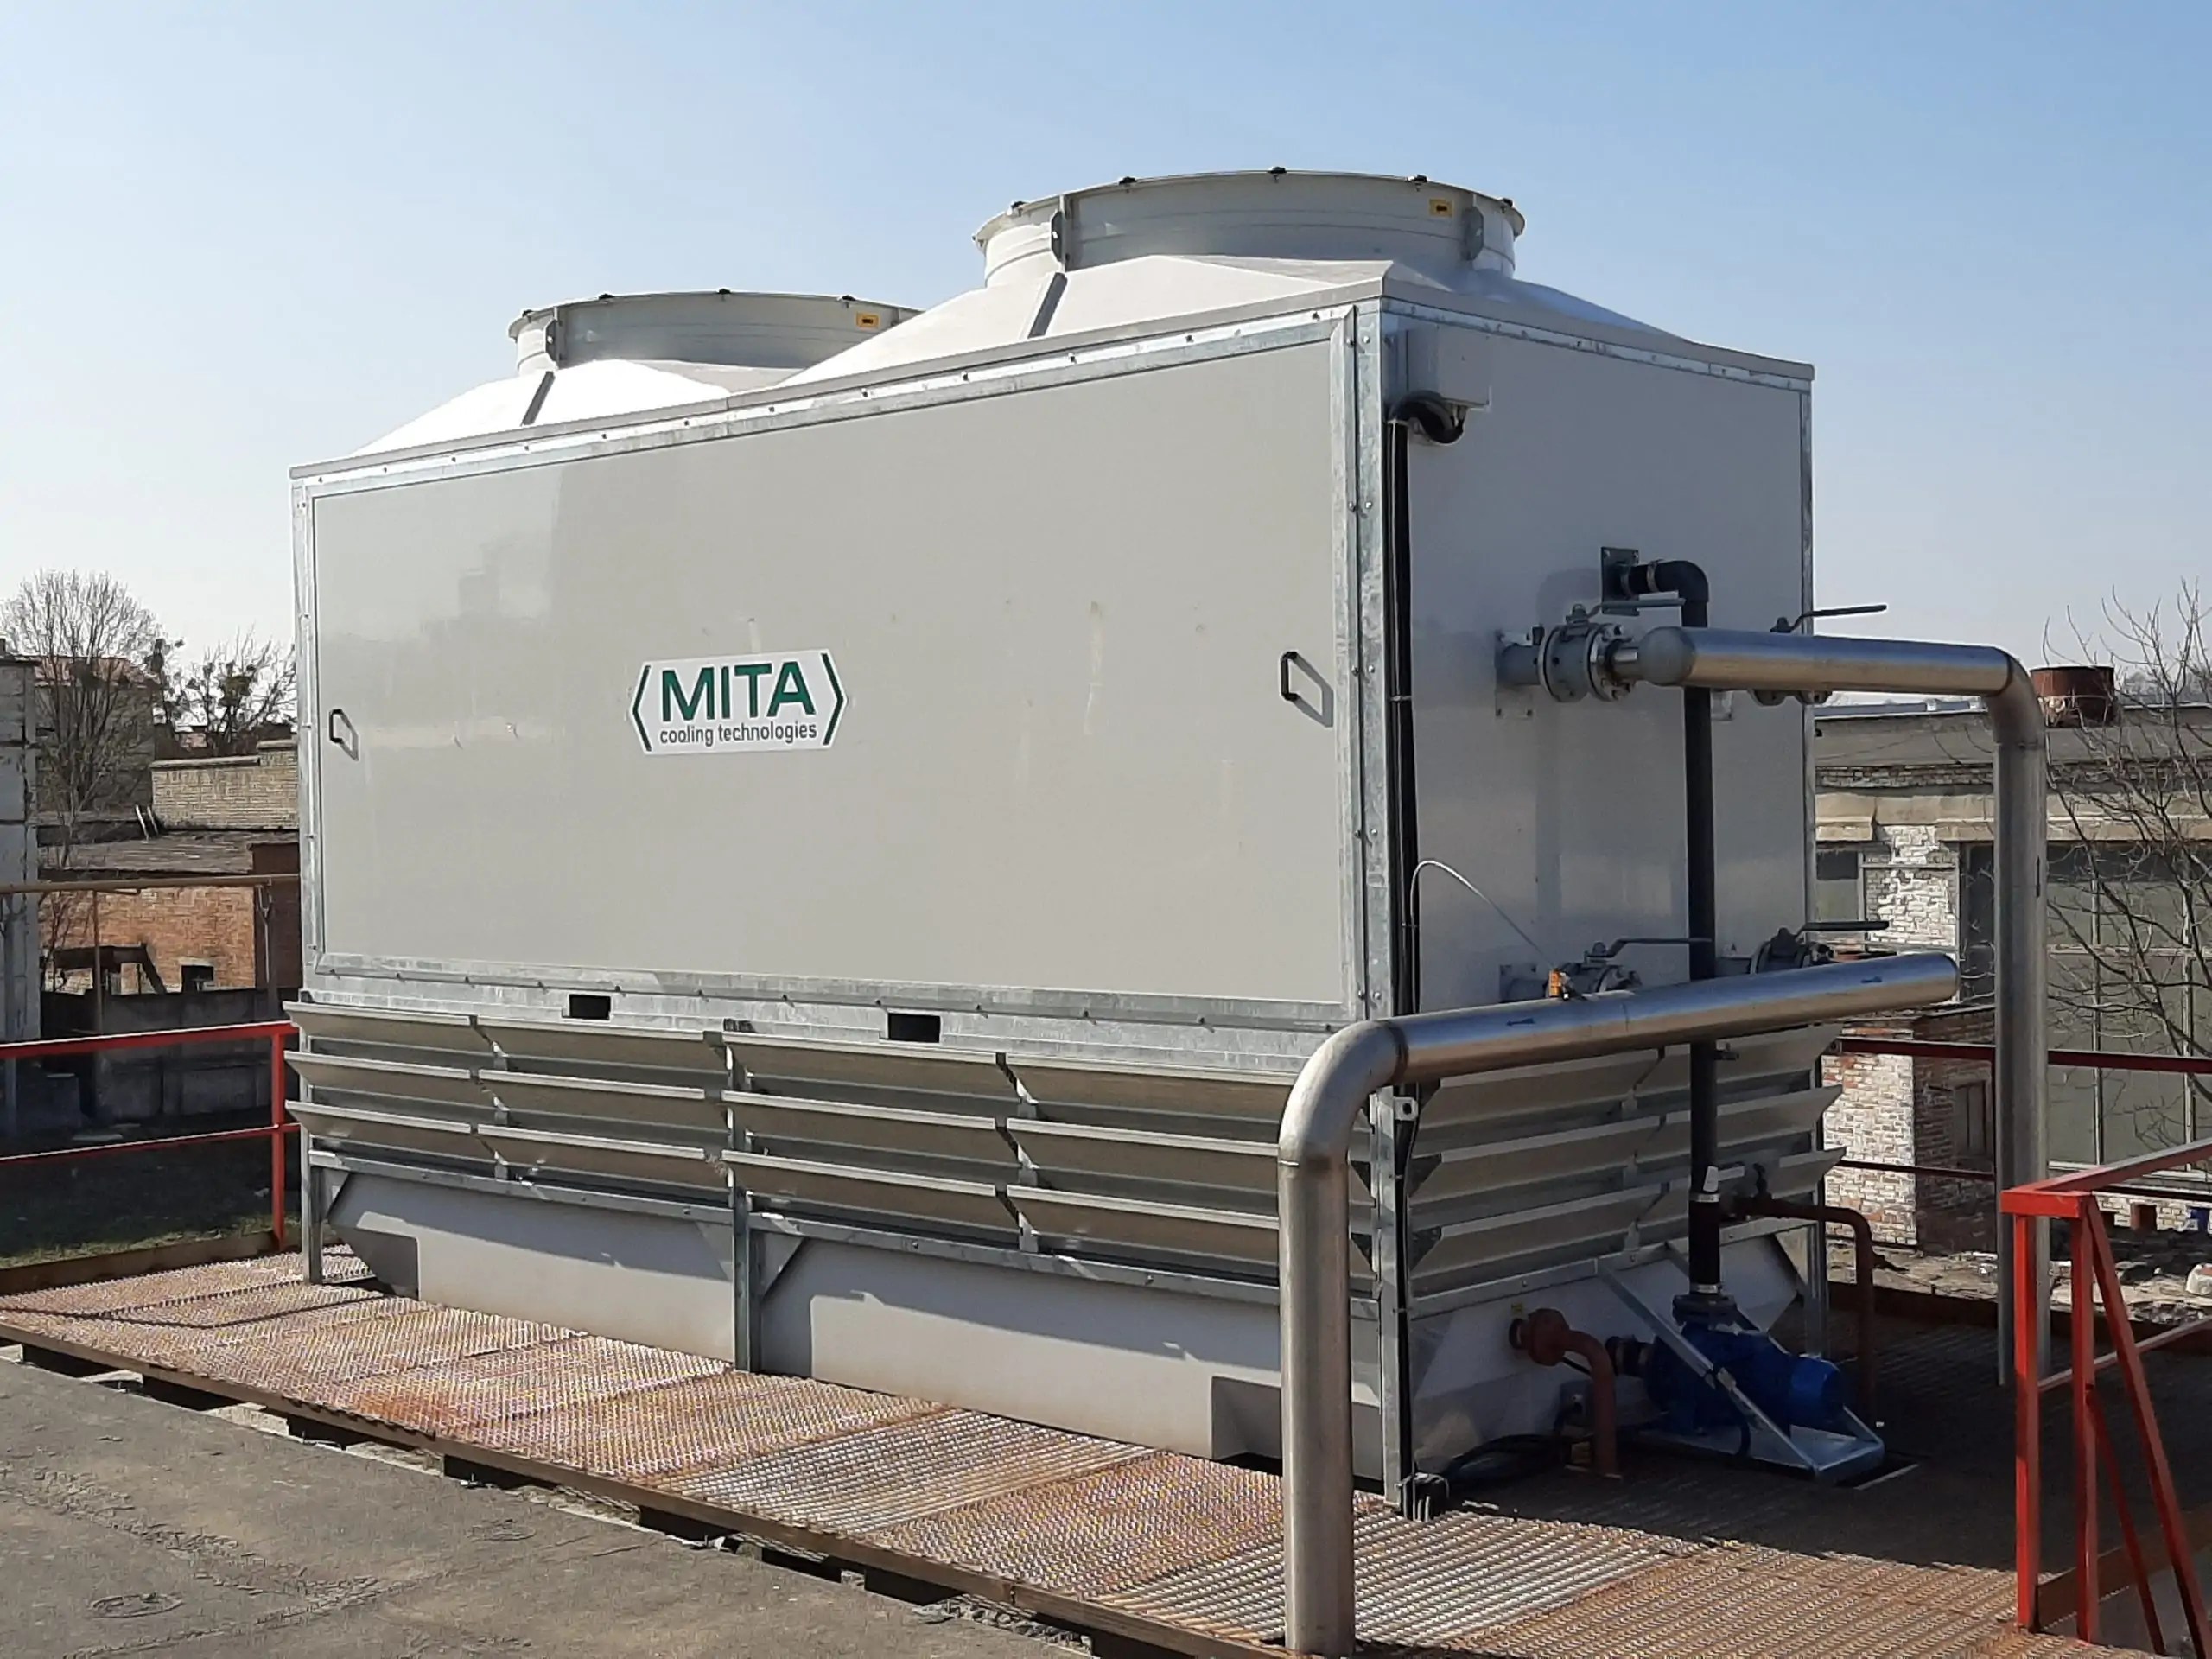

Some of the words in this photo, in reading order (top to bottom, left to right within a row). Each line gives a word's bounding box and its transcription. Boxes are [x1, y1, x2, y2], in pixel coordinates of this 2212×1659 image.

[662, 661, 816, 721] MITA
[660, 724, 713, 747] cooling
[718, 721, 817, 744] technologies
